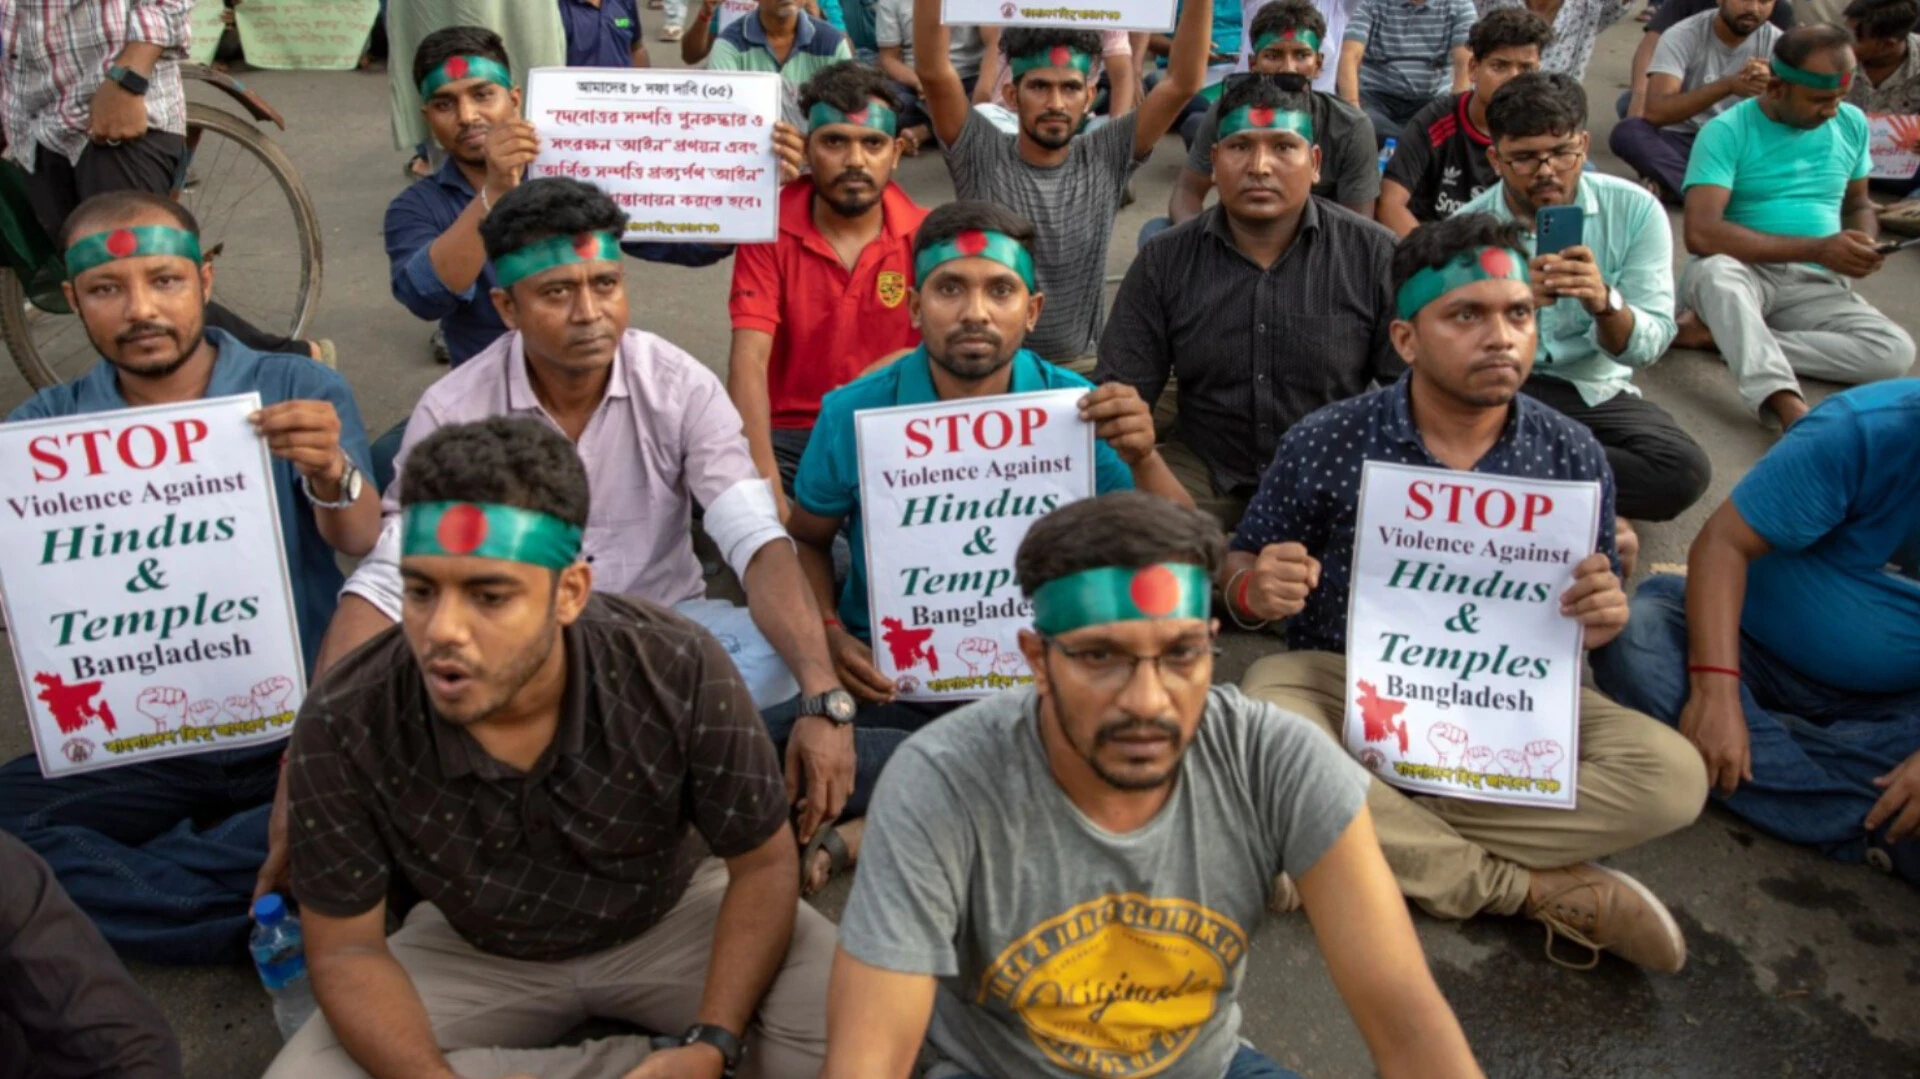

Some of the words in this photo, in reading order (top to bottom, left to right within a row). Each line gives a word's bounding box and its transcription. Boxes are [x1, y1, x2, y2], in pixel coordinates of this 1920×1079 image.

[576, 80, 627, 94] আমাদের
[645, 82, 670, 95] দফা
[673, 80, 699, 95] দাবি
[623, 106, 672, 126] সম্পত্তি
[678, 110, 747, 131] পুনরুদ্ধার
[751, 114, 764, 127] ও
[724, 140, 760, 155] এবং
[595, 161, 645, 180] সম্পত্তি
[679, 194, 723, 211] করতে
[28, 419, 209, 483] STOP
[904, 407, 1048, 459] STOP
[882, 465, 980, 488] Violence
[985, 454, 1073, 481] Against
[7, 487, 133, 520] Violence
[142, 471, 247, 505] Against
[898, 488, 1060, 527] Hindus
[1404, 480, 1554, 532] STOP
[37, 514, 237, 566] Hindus
[963, 525, 998, 557] &
[1377, 525, 1475, 556] Violence
[1480, 539, 1572, 565] Against
[125, 557, 170, 594] &
[900, 567, 1020, 597] Temp
[1384, 558, 1553, 603] Hindus
[50, 592, 260, 648] Temples
[911, 597, 1035, 627] Banglade
[1444, 602, 1482, 634] &
[71, 634, 252, 680] Bangladesh
[1377, 632, 1553, 682] Temples
[1386, 675, 1536, 713] Bangladesh
